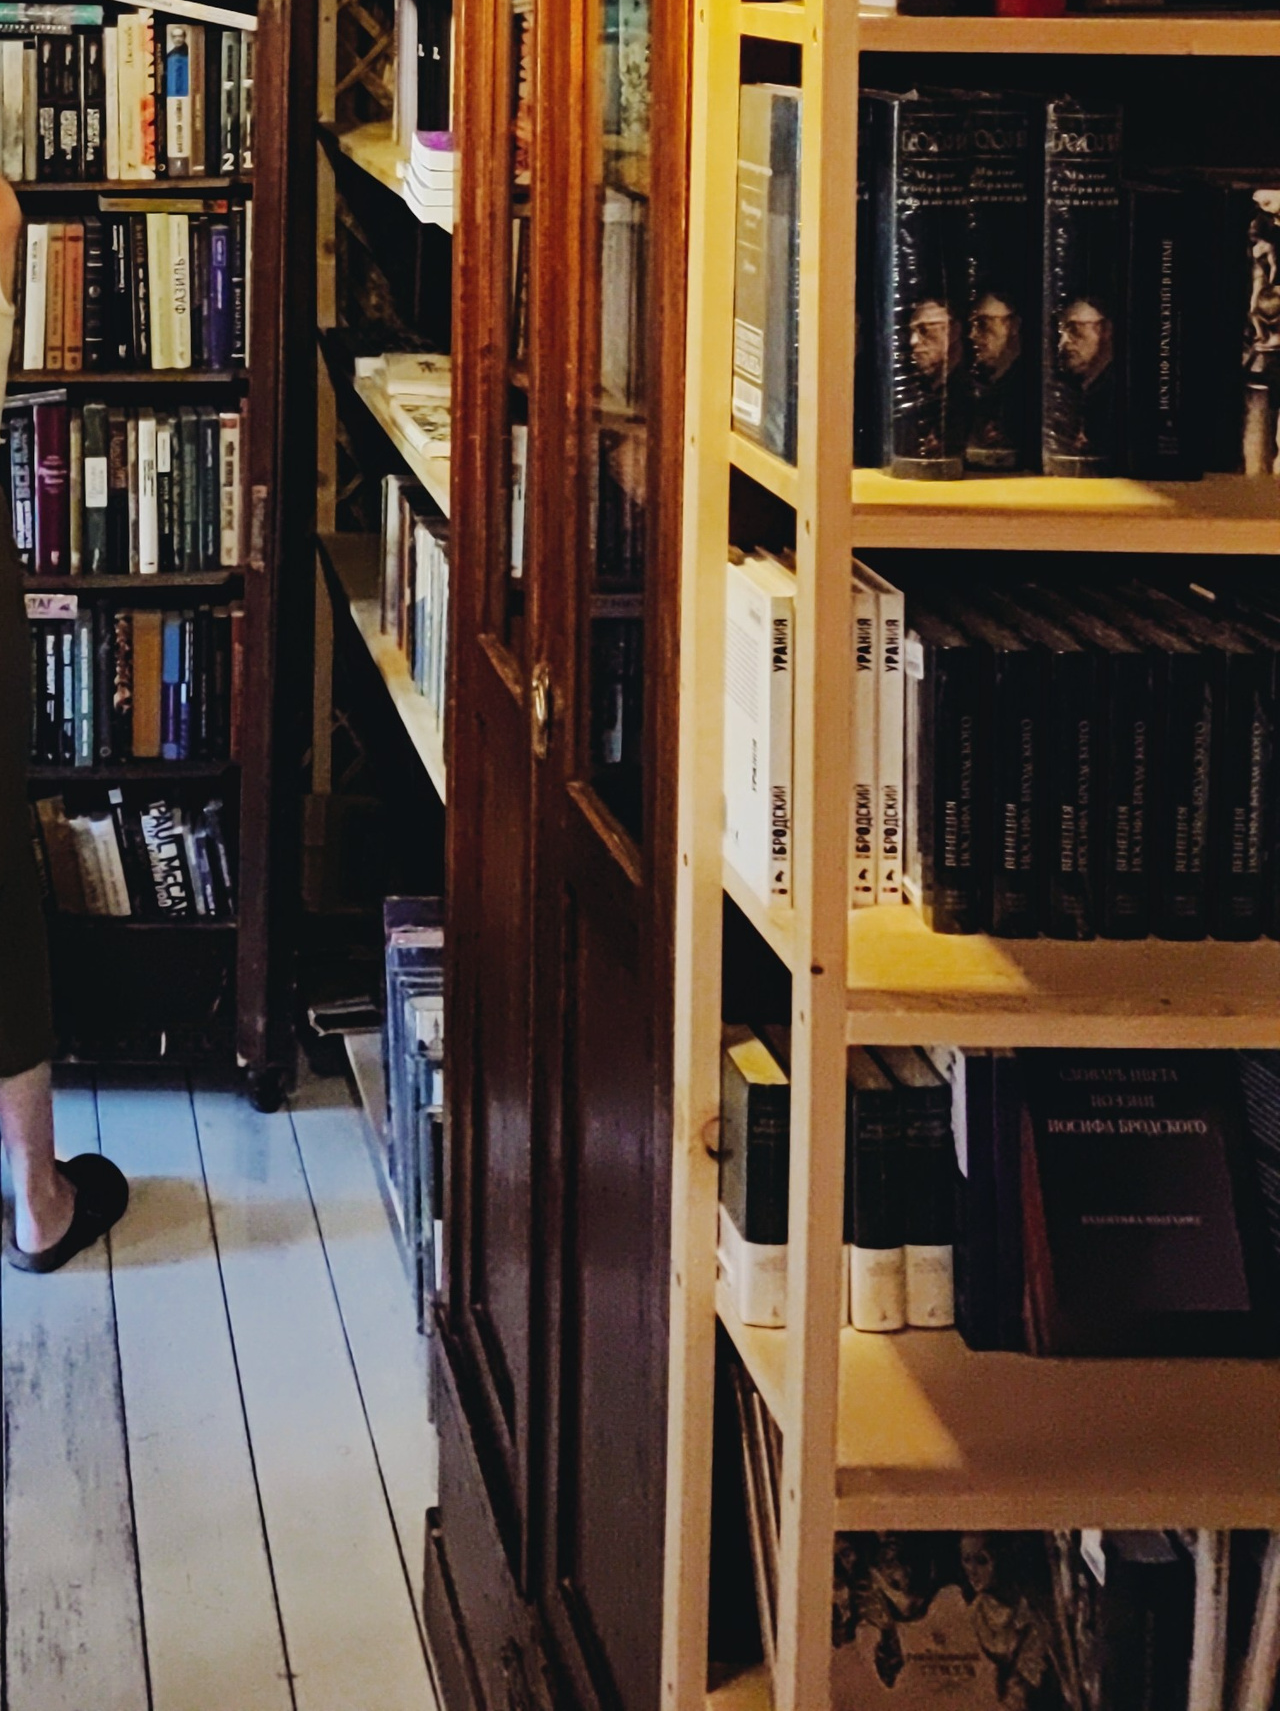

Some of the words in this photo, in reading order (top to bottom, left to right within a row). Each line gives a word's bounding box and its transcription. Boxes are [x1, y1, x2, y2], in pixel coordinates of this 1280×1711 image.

[222, 153, 234, 171] 2
[243, 151, 254, 168] 1
[174, 258, 186, 315] ФАЗИЛЬ
[773, 619, 788, 672] УРАНИЯ
[856, 618, 872, 672] УРАНИЯ
[885, 619, 899, 672] УРАНИЯ
[772, 786, 789, 855] БРОДСКИЙ
[855, 784, 873, 853] БРОДСКИЙ
[883, 785, 899, 854] БРОДСКИЙ
[1047, 1119, 1114, 1134] ИОСИФА
[1119, 1119, 1208, 1137] БРОДСКОГО
